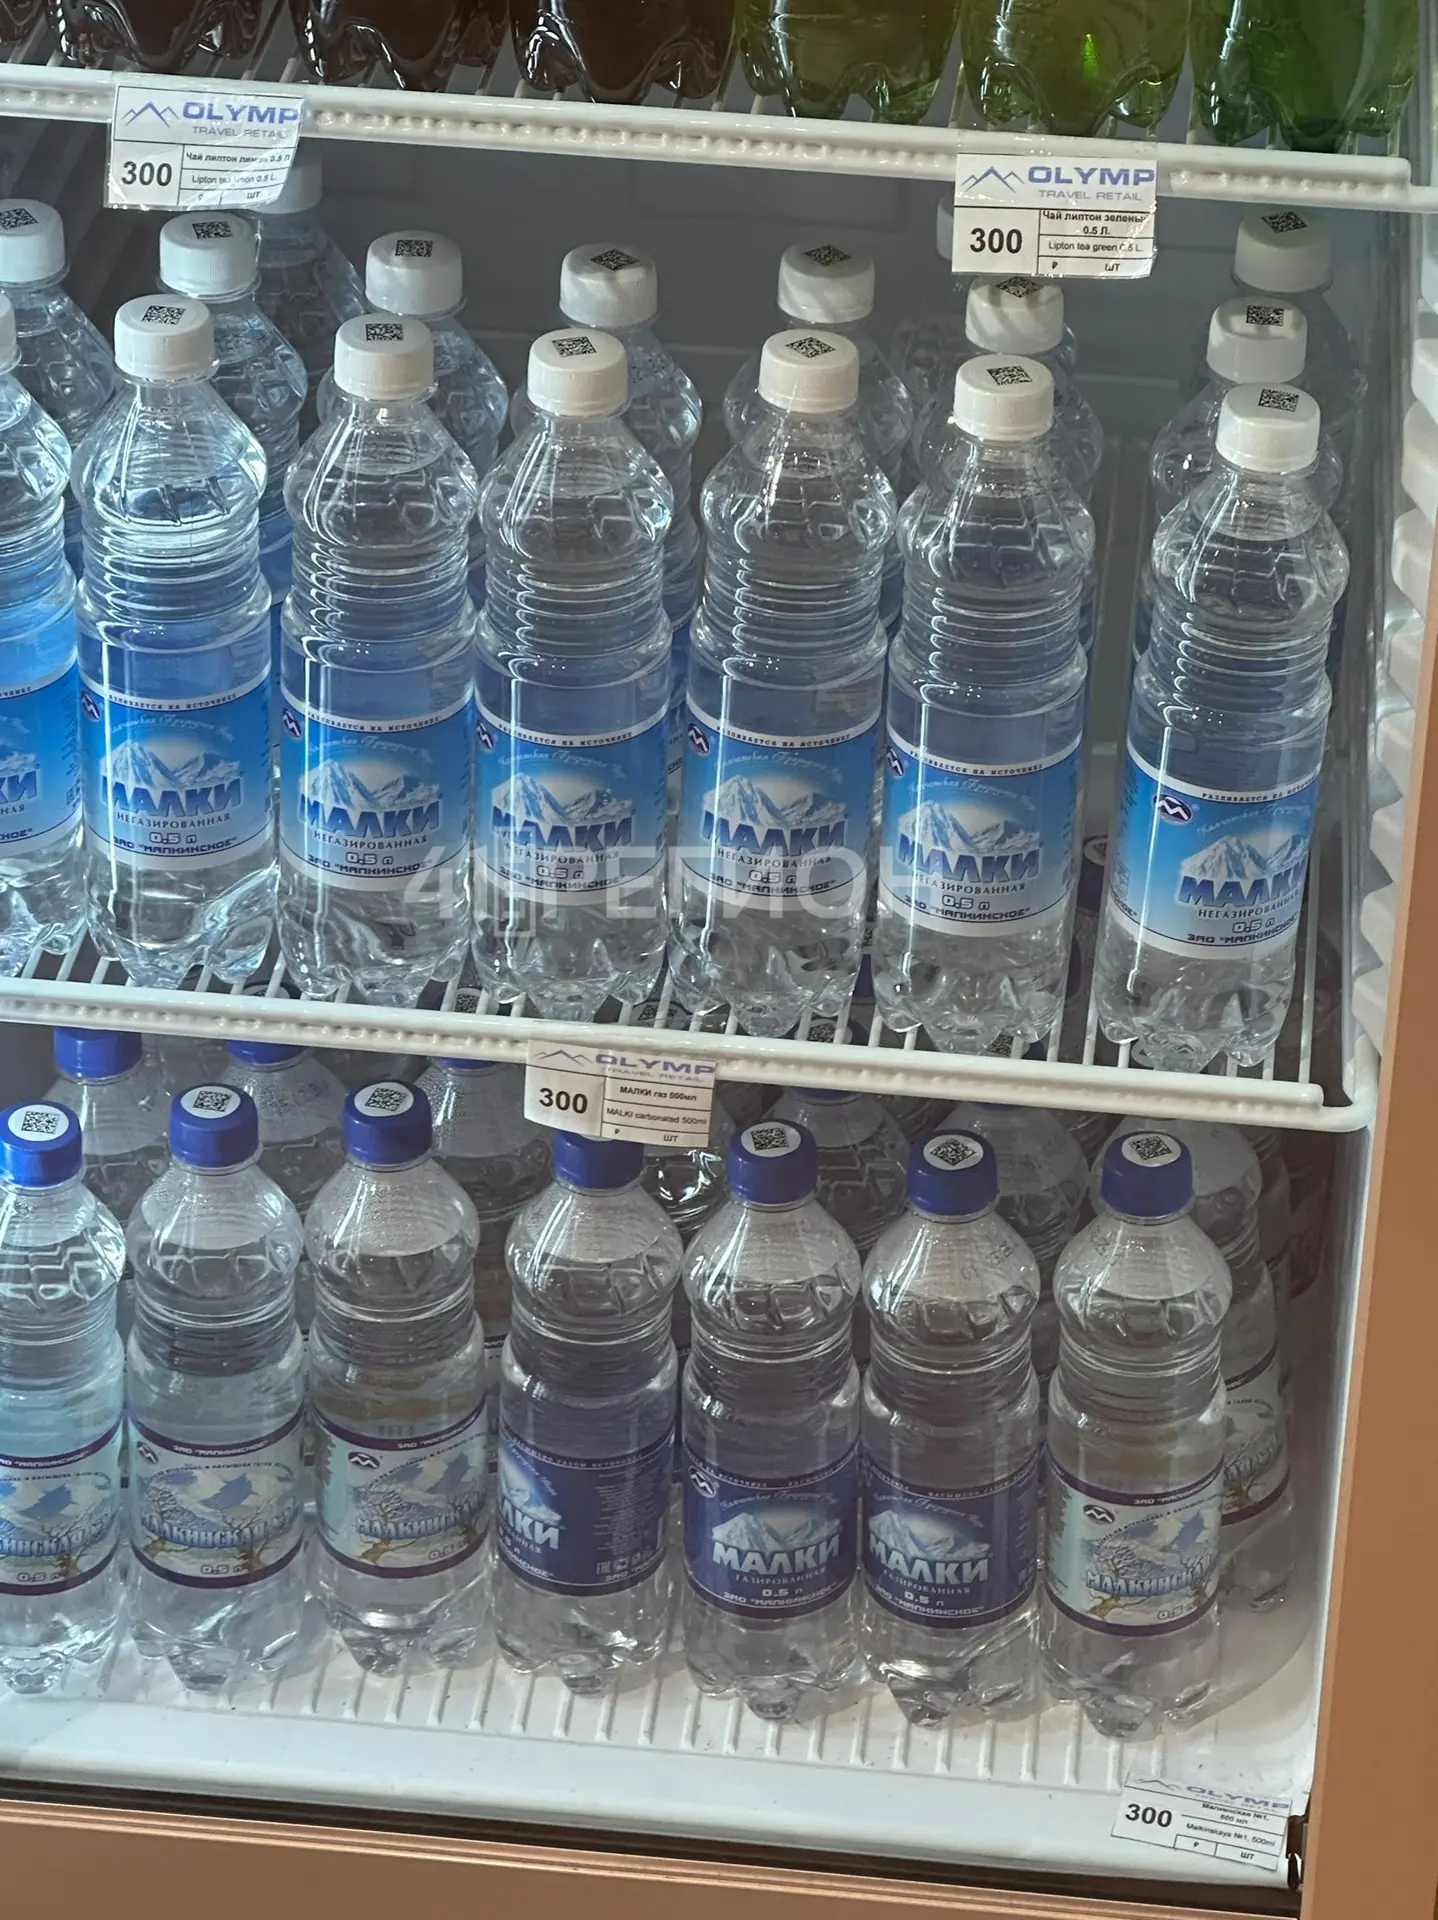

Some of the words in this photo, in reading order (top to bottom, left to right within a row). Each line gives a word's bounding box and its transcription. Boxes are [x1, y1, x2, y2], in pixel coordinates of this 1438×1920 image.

[183, 101, 298, 124] OLYMP
[192, 125, 238, 137] TRAVEL
[186, 152, 203, 161] Чай
[205, 154, 238, 163] липтон
[121, 161, 173, 187] 300
[192, 175, 217, 185] Lipton
[1028, 166, 1155, 186] OLYMP
[246, 191, 261, 199] ШТ
[1039, 189, 1091, 200] TRAVEL
[1096, 191, 1142, 201] RETAIL
[1043, 210, 1063, 220] Чай
[1064, 213, 1102, 222] липтон
[1083, 226, 1098, 235] 0.5
[1100, 226, 1111, 235] Л.
[970, 228, 1023, 254] 300
[1049, 241, 1075, 251] Lipton
[1076, 242, 1090, 250] tea
[1092, 243, 1118, 253] green
[1104, 263, 1120, 271] ШТ
[106, 692, 163, 710] АЗЛИВАЕТСЯ
[910, 750, 968, 773] РАЛИВАЕТСЯ
[1202, 792, 1268, 802] РАЗЛИВАЕТСЯ
[117, 812, 231, 829] НЕГАЗИРОВАННАЯ
[301, 793, 440, 839] МАЛКИ
[493, 805, 632, 852] МАЛКИ
[703, 810, 846, 857] МАЛКИ
[113, 835, 134, 849] ЗАО
[314, 831, 428, 850] НЕГАЗИРОВАННАЯ
[308, 853, 331, 869] ЗАО
[345, 852, 378, 865] 0.5
[717, 849, 832, 868] НЕГАЗИРОВАННАЯ
[899, 833, 1040, 884] МАЛКИ
[913, 873, 1026, 894] НЕГАЗИРОВАННАЯ
[942, 895, 974, 910] 0.5
[1232, 919, 1263, 935] 0.5
[1187, 933, 1215, 944] ЗАО
[595, 1054, 715, 1074] OLYMP
[539, 1087, 588, 1114] 300
[620, 1086, 651, 1097] МАЛКИ
[653, 1090, 667, 1099] газ
[669, 1091, 697, 1101] 500мл
[606, 1107, 634, 1118] MALKI
[635, 1112, 680, 1124] carbonated
[682, 1116, 706, 1126] 500ml
[663, 1134, 678, 1142] ШТ
[713, 1533, 840, 1575] МАЛКИ
[870, 1532, 989, 1585] МАЛКИ
[735, 1567, 826, 1585] ГАЗИРОВАННАЯ
[723, 1591, 746, 1604] ЗАО
[762, 1588, 789, 1597] 0.5
[904, 1591, 930, 1605] 0.5
[1186, 1786, 1289, 1809] OLYMP
[1125, 1803, 1173, 1828] 300
[1186, 1823, 1232, 1838] Malkinskaya
[1252, 1835, 1276, 1847] 500ml
[1240, 1851, 1255, 1860] ШТ
